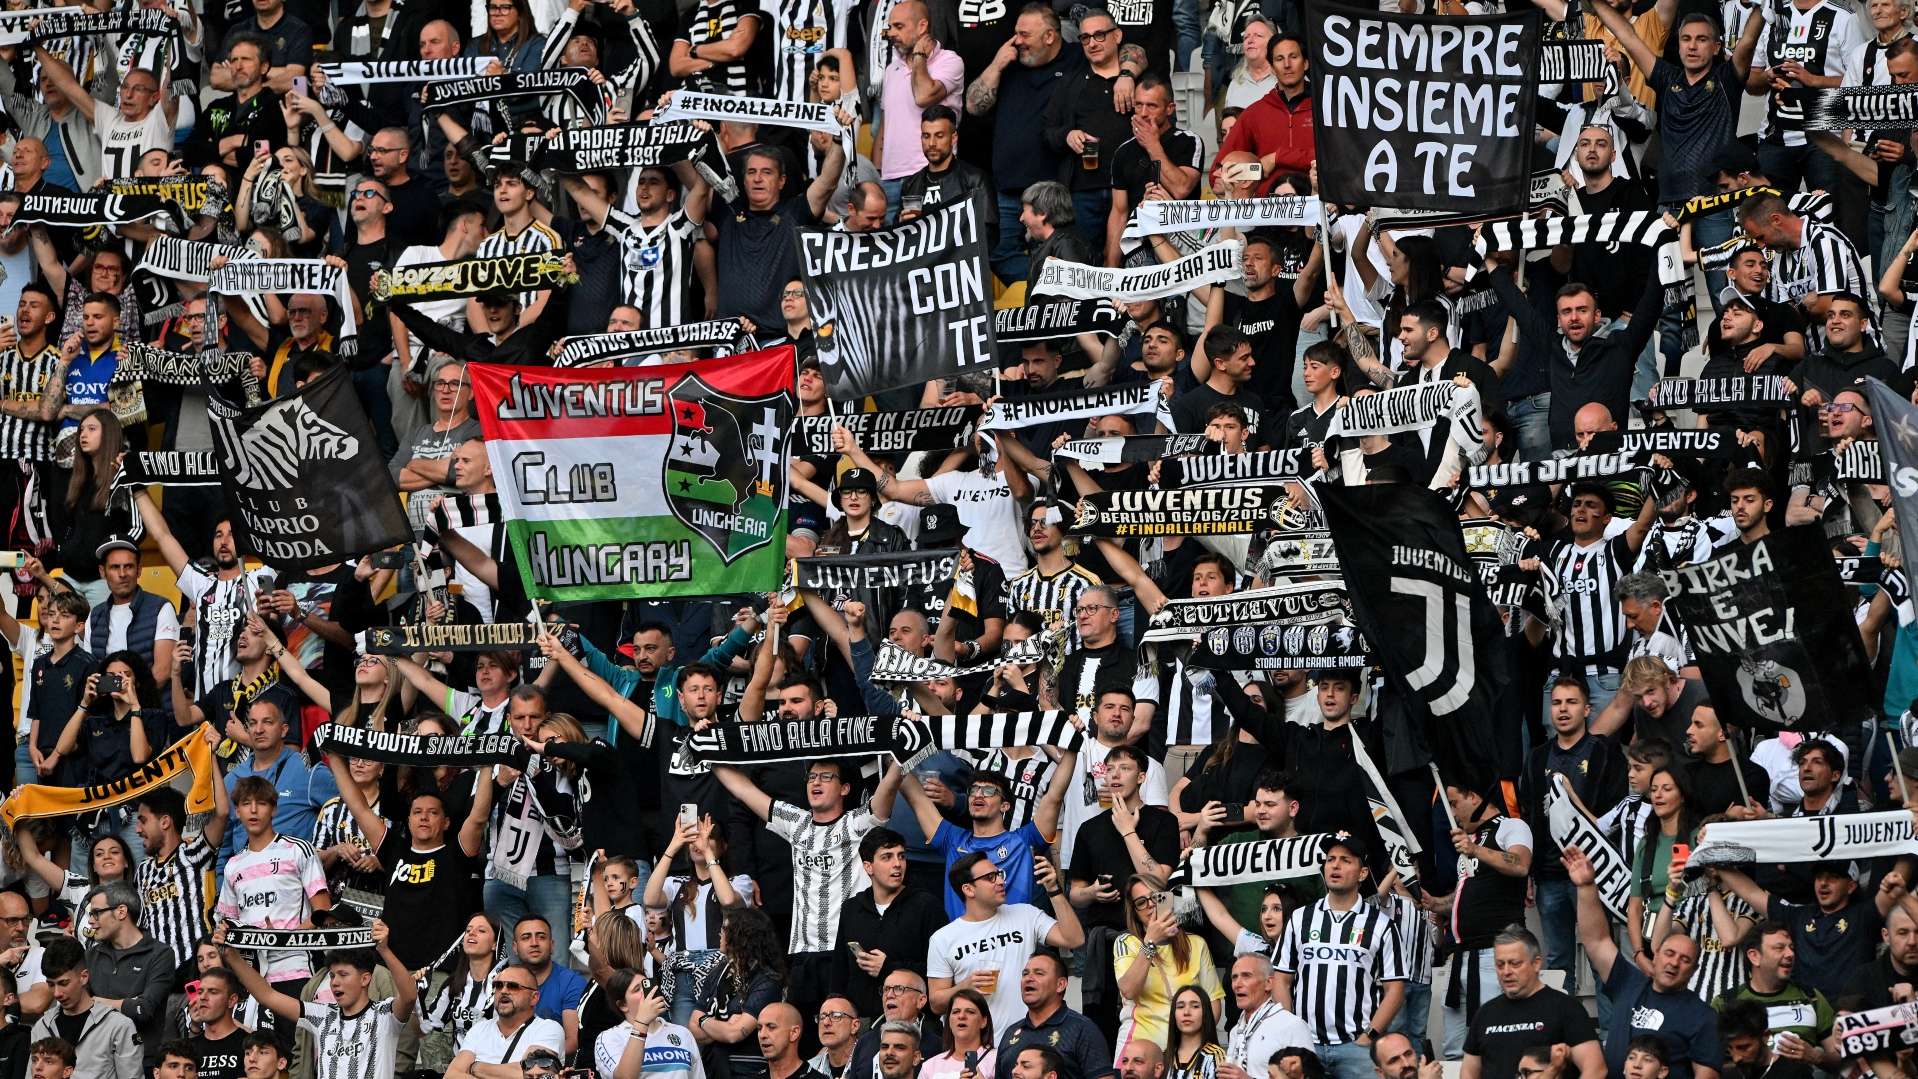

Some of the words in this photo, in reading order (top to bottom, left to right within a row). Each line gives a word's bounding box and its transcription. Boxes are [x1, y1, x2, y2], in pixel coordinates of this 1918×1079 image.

[127, 9, 171, 33] FINE
[1324, 15, 1523, 75] SEMPRE
[1774, 43, 1815, 62] Jeep
[434, 76, 502, 101] JUVENTUS
[681, 96, 827, 121] #FINOALLAFINE
[1324, 75, 1521, 136] INSIEME
[569, 129, 624, 150] PADRE
[628, 128, 646, 146] IN
[652, 126, 705, 145] FIGLIO
[576, 148, 620, 170] SINCE
[624, 146, 664, 166] 1897
[1365, 139, 1397, 192] A
[1414, 142, 1477, 197] TE
[1158, 199, 1203, 227] FINE
[801, 198, 977, 276] CRESCIUTI
[391, 266, 459, 286] Forza
[453, 255, 542, 292] JUVE
[908, 257, 984, 316] CON
[994, 308, 1036, 333] ALLA
[1040, 302, 1080, 328] FINE
[632, 329, 674, 348] CLUB
[676, 322, 740, 342] VARESE
[949, 316, 990, 366] TE
[498, 374, 665, 418] JUVENTUS
[1695, 377, 1745, 404] ALLA
[875, 410, 895, 430] IN
[898, 406, 966, 428] FIGLIO
[869, 430, 918, 451] 1897
[1618, 432, 1720, 452] JUVENTUS
[139, 451, 180, 475] FINO
[185, 451, 219, 475] ALL
[1177, 447, 1303, 485] JUVENTUS
[512, 451, 616, 504] CLUB
[1108, 487, 1263, 512] JUVENTUS
[240, 507, 320, 534] VAPRIO
[692, 509, 767, 537] UNGHERIA
[1101, 512, 1165, 524] BERLINO
[1171, 509, 1267, 523] 06/06/2015
[1115, 521, 1254, 535] #FINOALLAFINALE
[249, 534, 333, 559] D'ADDA
[530, 532, 691, 586] HUNGARY
[807, 557, 954, 589] JUVENTUS
[1391, 545, 1472, 583] JUVENTUS
[1659, 540, 1774, 597] BIRRA
[204, 605, 241, 624] Jeep
[1709, 590, 1738, 620] E
[402, 626, 420, 647] JC
[1693, 607, 1795, 653] JUVE!
[1255, 657, 1282, 669] STORIA
[1284, 658, 1292, 669] DI
[1293, 658, 1304, 668] UN
[1305, 657, 1337, 668] GRANDE
[1338, 655, 1366, 667] AMORE
[314, 723, 332, 747] WE
[334, 725, 365, 746] ARE
[367, 730, 423, 755] YOUTH.
[426, 736, 475, 755] SINCE
[739, 723, 783, 752] FINO
[787, 719, 832, 749] ALLA
[837, 716, 878, 745] FINE
[799, 855, 834, 870] Jeep
[238, 891, 277, 910] Jeep
[240, 932, 277, 946] FINO
[286, 934, 327, 946] ALLA
[337, 930, 373, 945] FINE
[1302, 946, 1367, 963] SONY
[327, 1042, 364, 1057] Jeep
